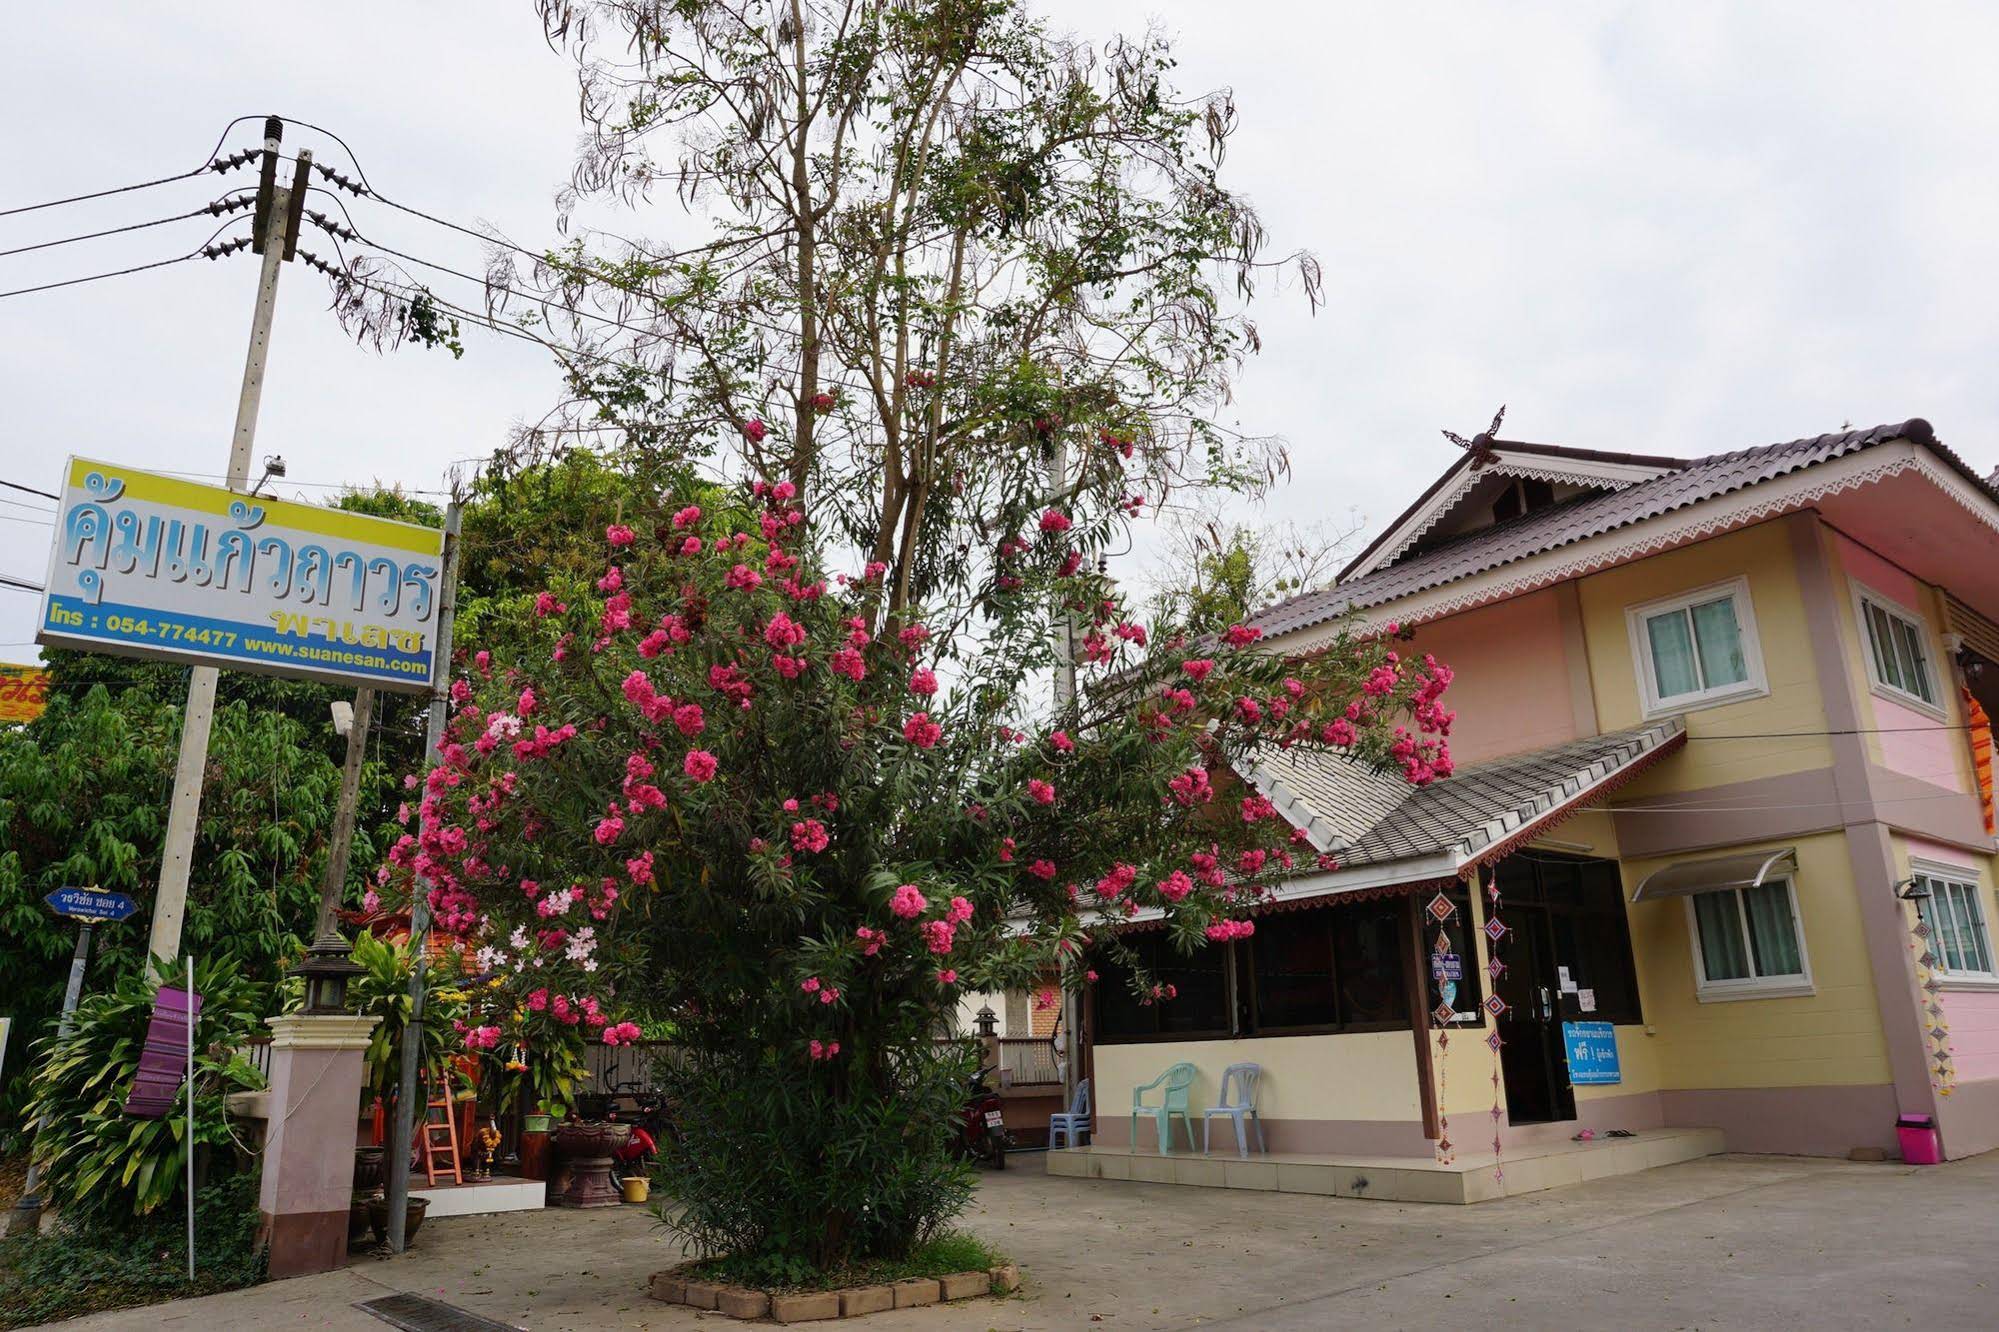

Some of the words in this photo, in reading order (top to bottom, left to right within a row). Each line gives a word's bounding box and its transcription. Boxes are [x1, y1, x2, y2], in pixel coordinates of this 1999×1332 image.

[65, 472, 439, 622] คุ้มแก้วถาวร
[49, 602, 83, 626] โทร
[106, 615, 237, 648] 054-774477
[270, 608, 425, 654] พาเลซ
[244, 638, 427, 675] www.suanesan.com
[1574, 1041, 1588, 1060] ฟรี
